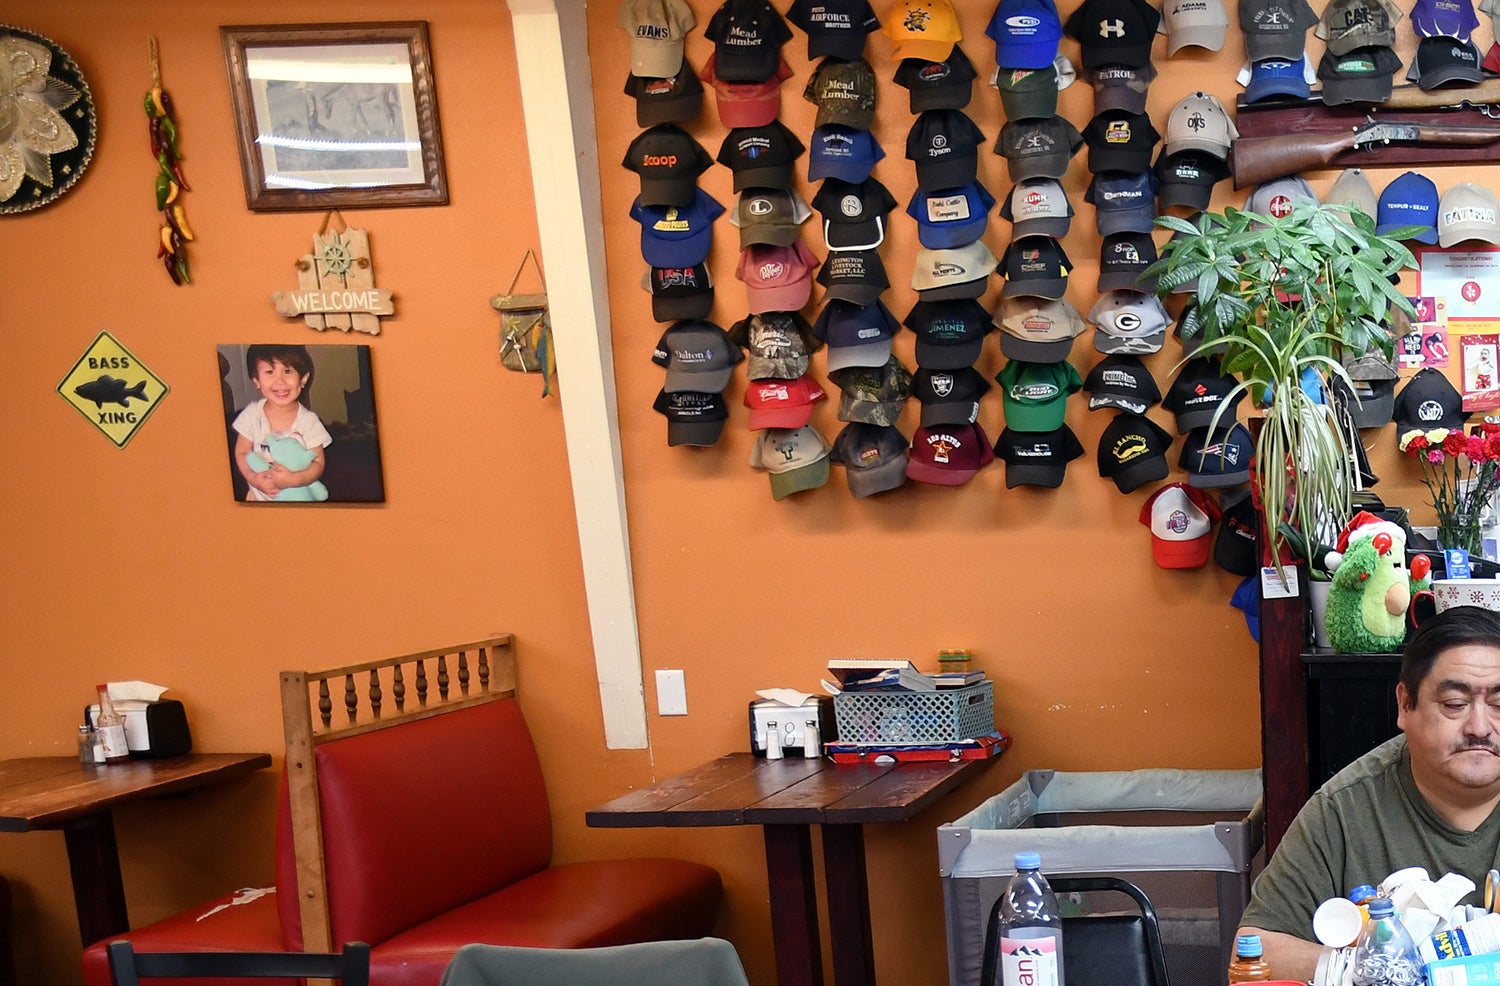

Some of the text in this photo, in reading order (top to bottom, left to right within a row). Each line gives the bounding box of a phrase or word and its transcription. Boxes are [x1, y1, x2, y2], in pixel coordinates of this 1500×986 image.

[636, 25, 669, 40] EVANS
[731, 26, 757, 38] Mead
[726, 35, 762, 47] Lumber
[828, 80, 854, 91] Mead
[821, 87, 860, 101] Lumber
[929, 148, 952, 157] Tyson
[1024, 195, 1048, 204] KUHN
[657, 267, 699, 290] USA
[291, 290, 382, 312] WELCOME
[928, 324, 967, 334] JIMENEZ
[1404, 343, 1421, 351] NEED
[88, 356, 130, 370] BASS
[98, 411, 137, 425] XING
[926, 434, 939, 445] LOS
[1116, 434, 1147, 448] RANCHO
[784, 721, 796, 747] 8
[1435, 931, 1456, 959] Advil
